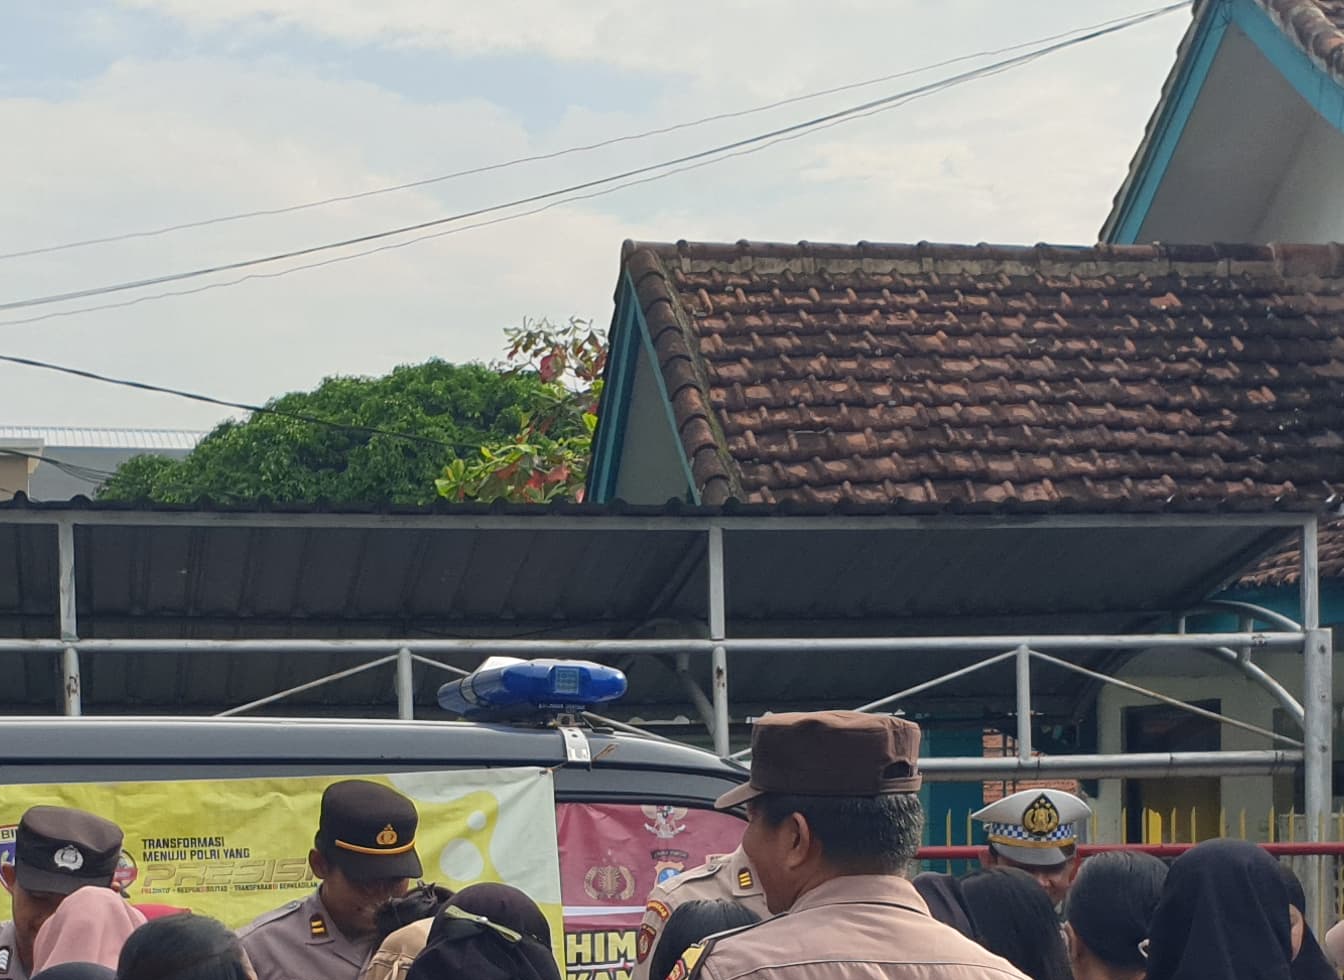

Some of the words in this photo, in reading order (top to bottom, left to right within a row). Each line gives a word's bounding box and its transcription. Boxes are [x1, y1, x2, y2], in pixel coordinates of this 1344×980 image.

[142, 836, 225, 850] TRANSFORMASI
[143, 851, 187, 862] MENUJU
[190, 850, 220, 860] POLRI
[223, 848, 250, 859] YANG
[566, 931, 636, 964] HIM
